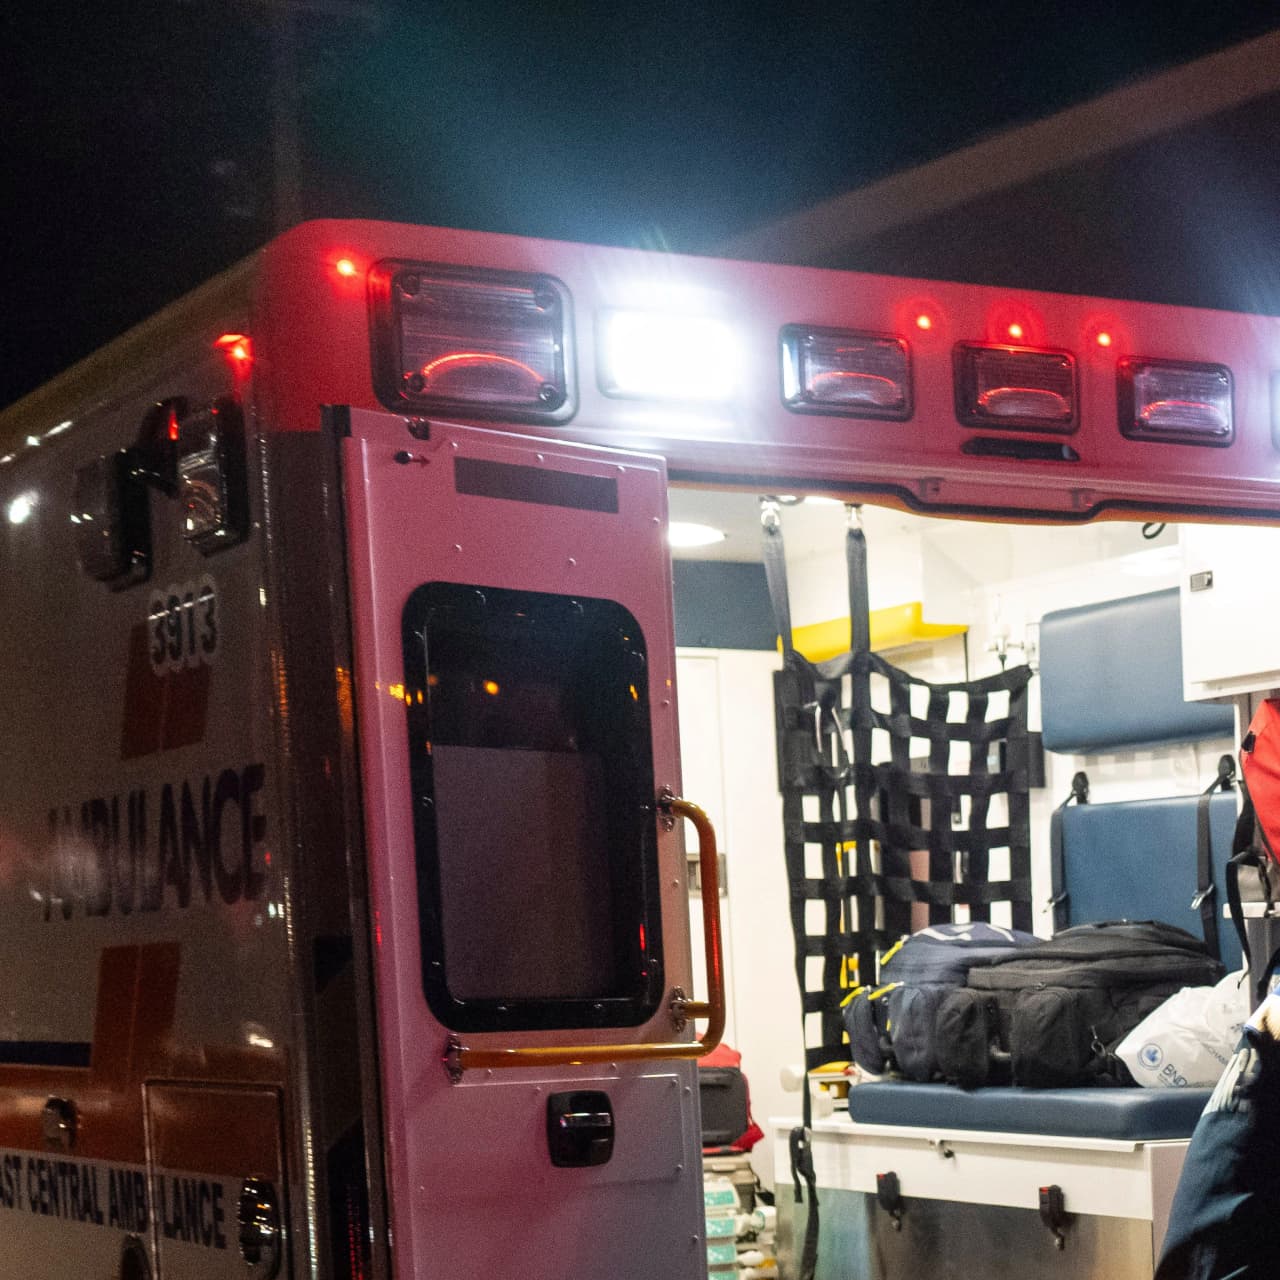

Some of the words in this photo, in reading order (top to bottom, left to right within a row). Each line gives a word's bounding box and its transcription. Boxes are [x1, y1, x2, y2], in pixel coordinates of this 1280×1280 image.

[151, 586, 217, 665] 3913
[28, 1157, 104, 1225] CENTRAL
[109, 1167, 227, 1250] AMBLANCE
